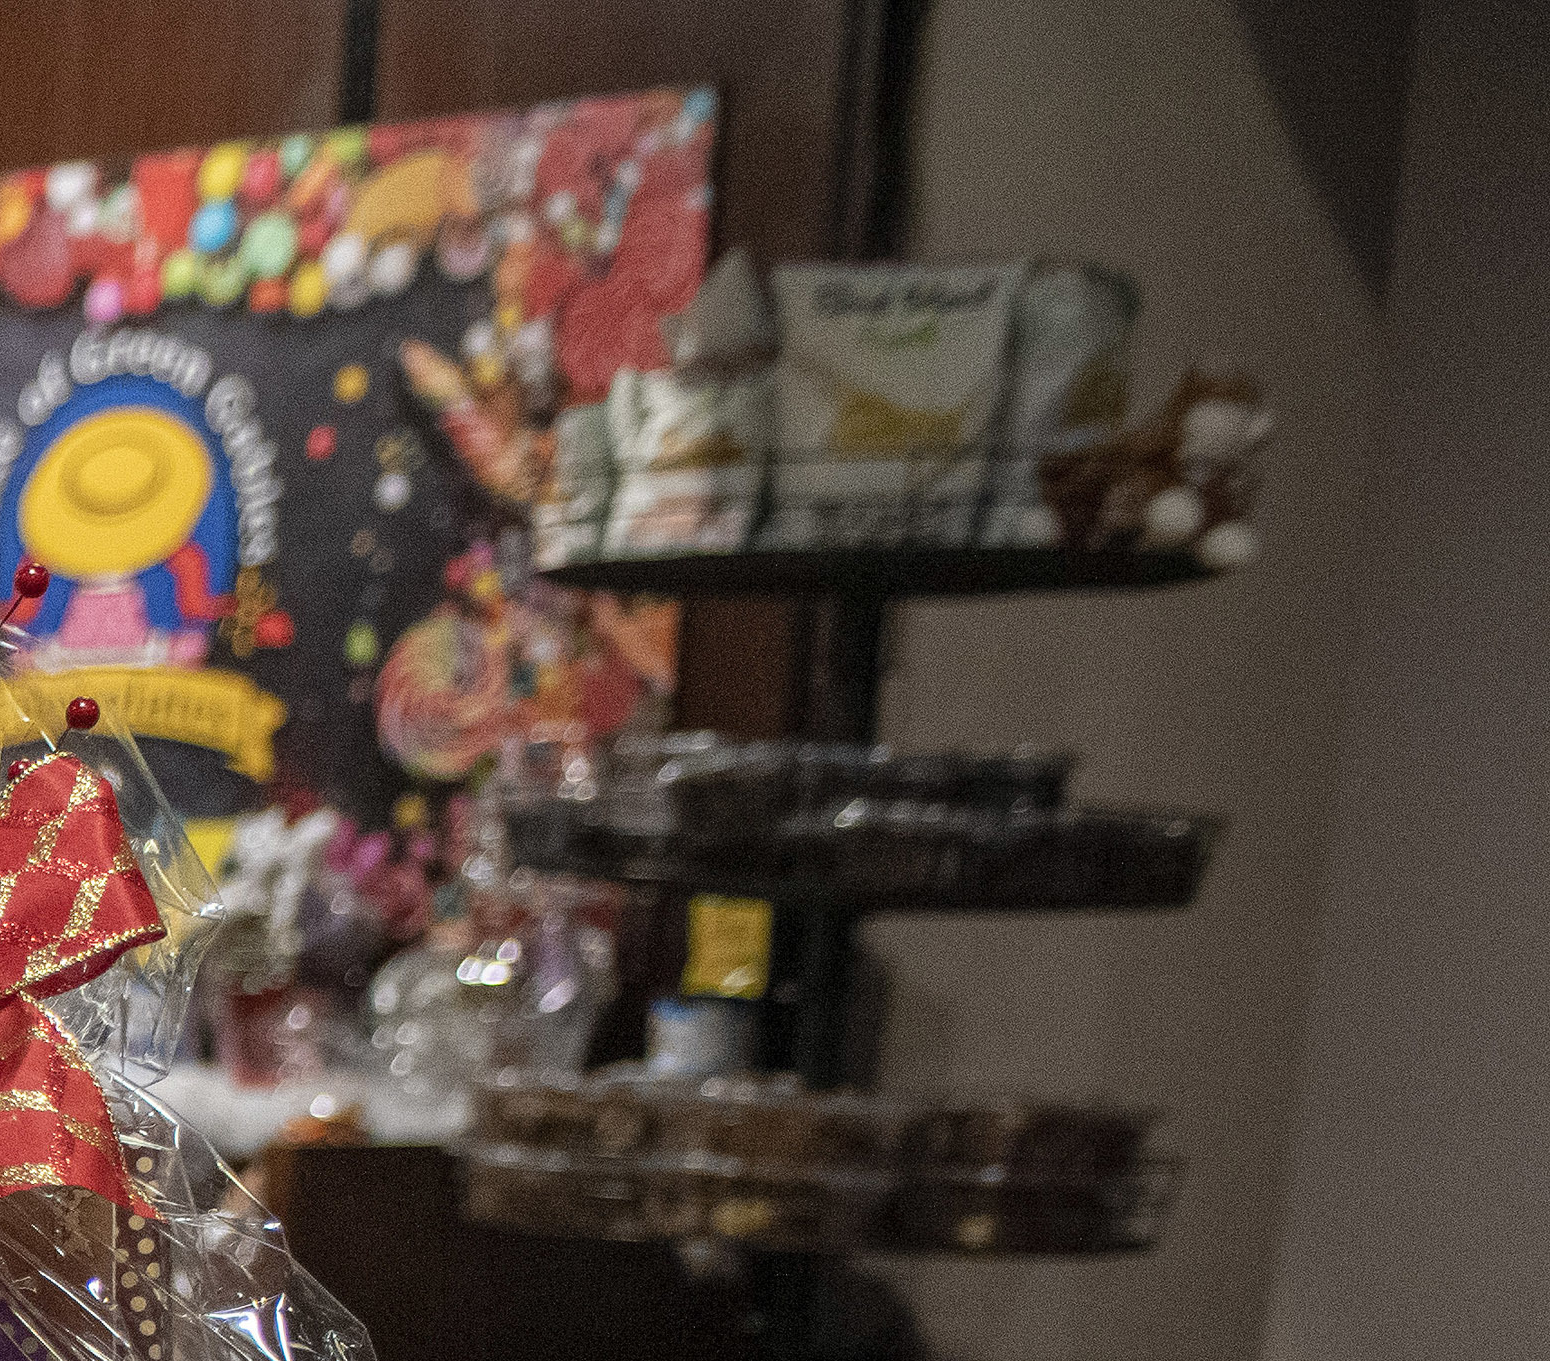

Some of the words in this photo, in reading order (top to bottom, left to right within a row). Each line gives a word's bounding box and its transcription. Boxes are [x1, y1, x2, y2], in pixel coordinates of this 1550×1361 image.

[18, 348, 72, 427] of
[69, 329, 213, 396] Green
[206, 372, 283, 568] Gables
